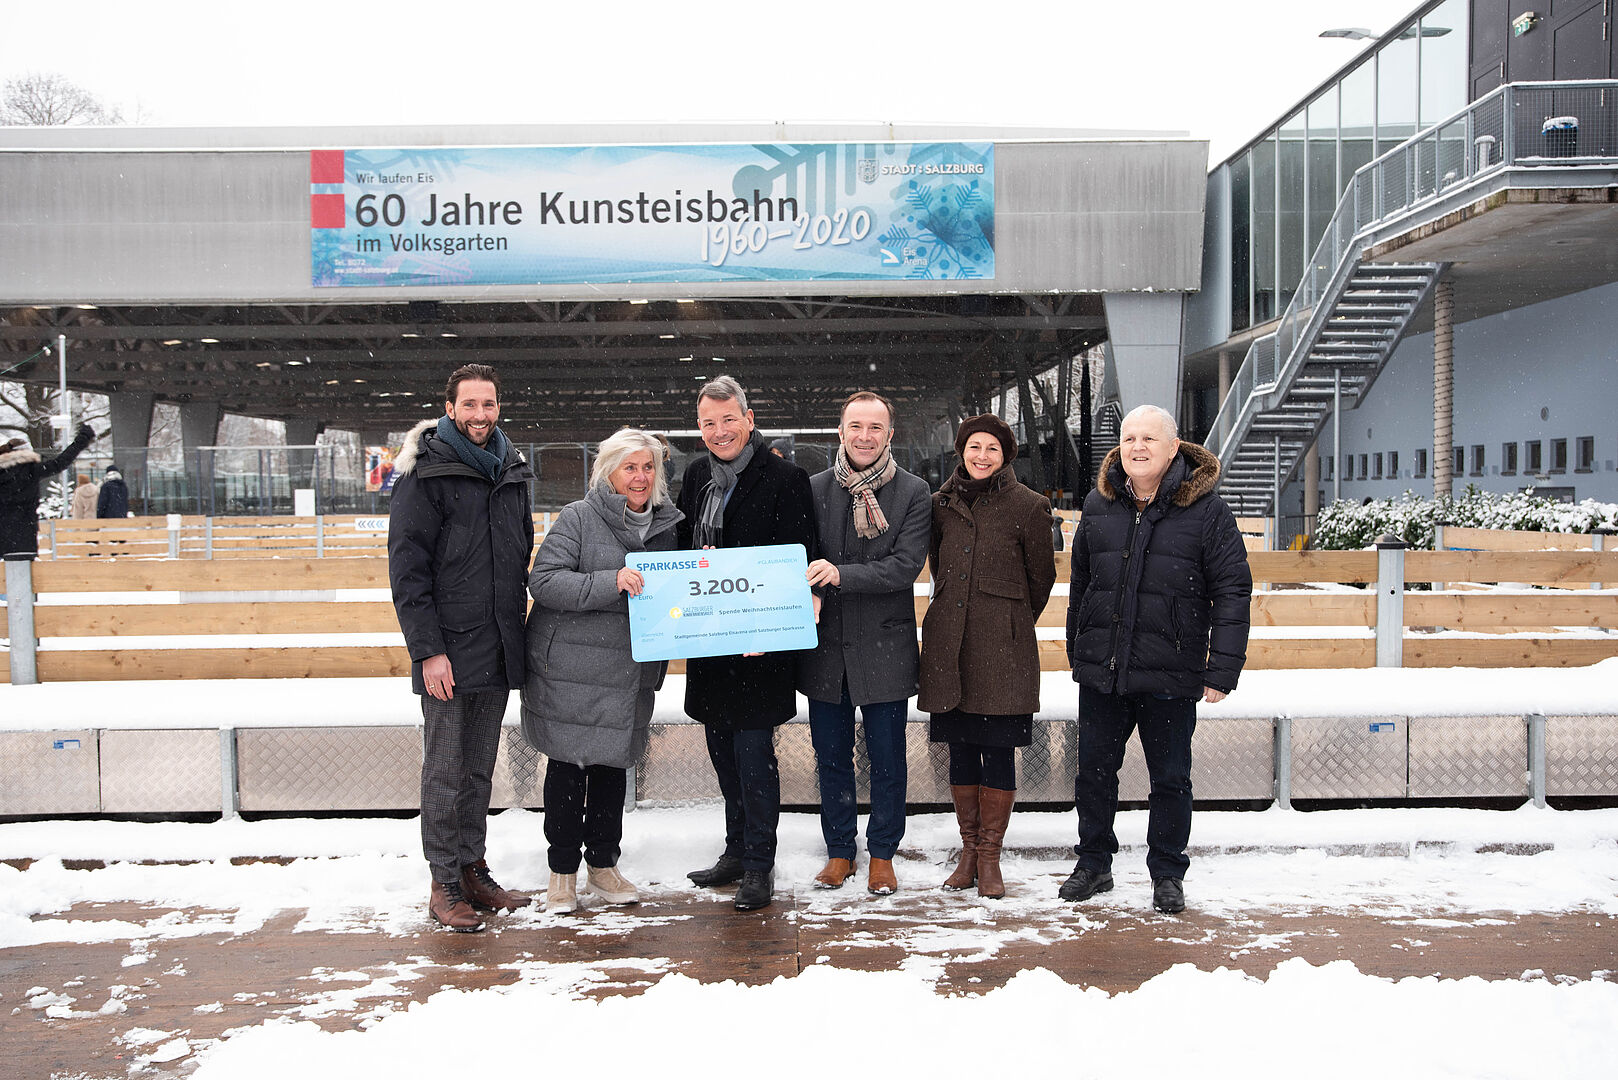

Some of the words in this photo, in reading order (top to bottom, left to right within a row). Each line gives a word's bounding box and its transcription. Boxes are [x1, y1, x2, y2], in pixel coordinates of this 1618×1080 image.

[881, 164, 916, 175] STADT
[925, 163, 985, 175] SALZBURG
[356, 172, 374, 184] Wir
[378, 172, 413, 184] laufen
[417, 172, 434, 184] Eis
[355, 193, 406, 228] 60
[421, 192, 523, 227] Jahre
[540, 189, 798, 225] Kunsteisbahn
[356, 234, 382, 253] im
[390, 232, 508, 256] Volksgarten
[903, 247, 917, 256] Eis
[903, 256, 928, 266] Arena
[636, 560, 697, 572] SPARKASSE
[688, 577, 765, 596] 3.200,-
[718, 608, 741, 616] Spende
[741, 604, 803, 614] Weihnachtseislaufen
